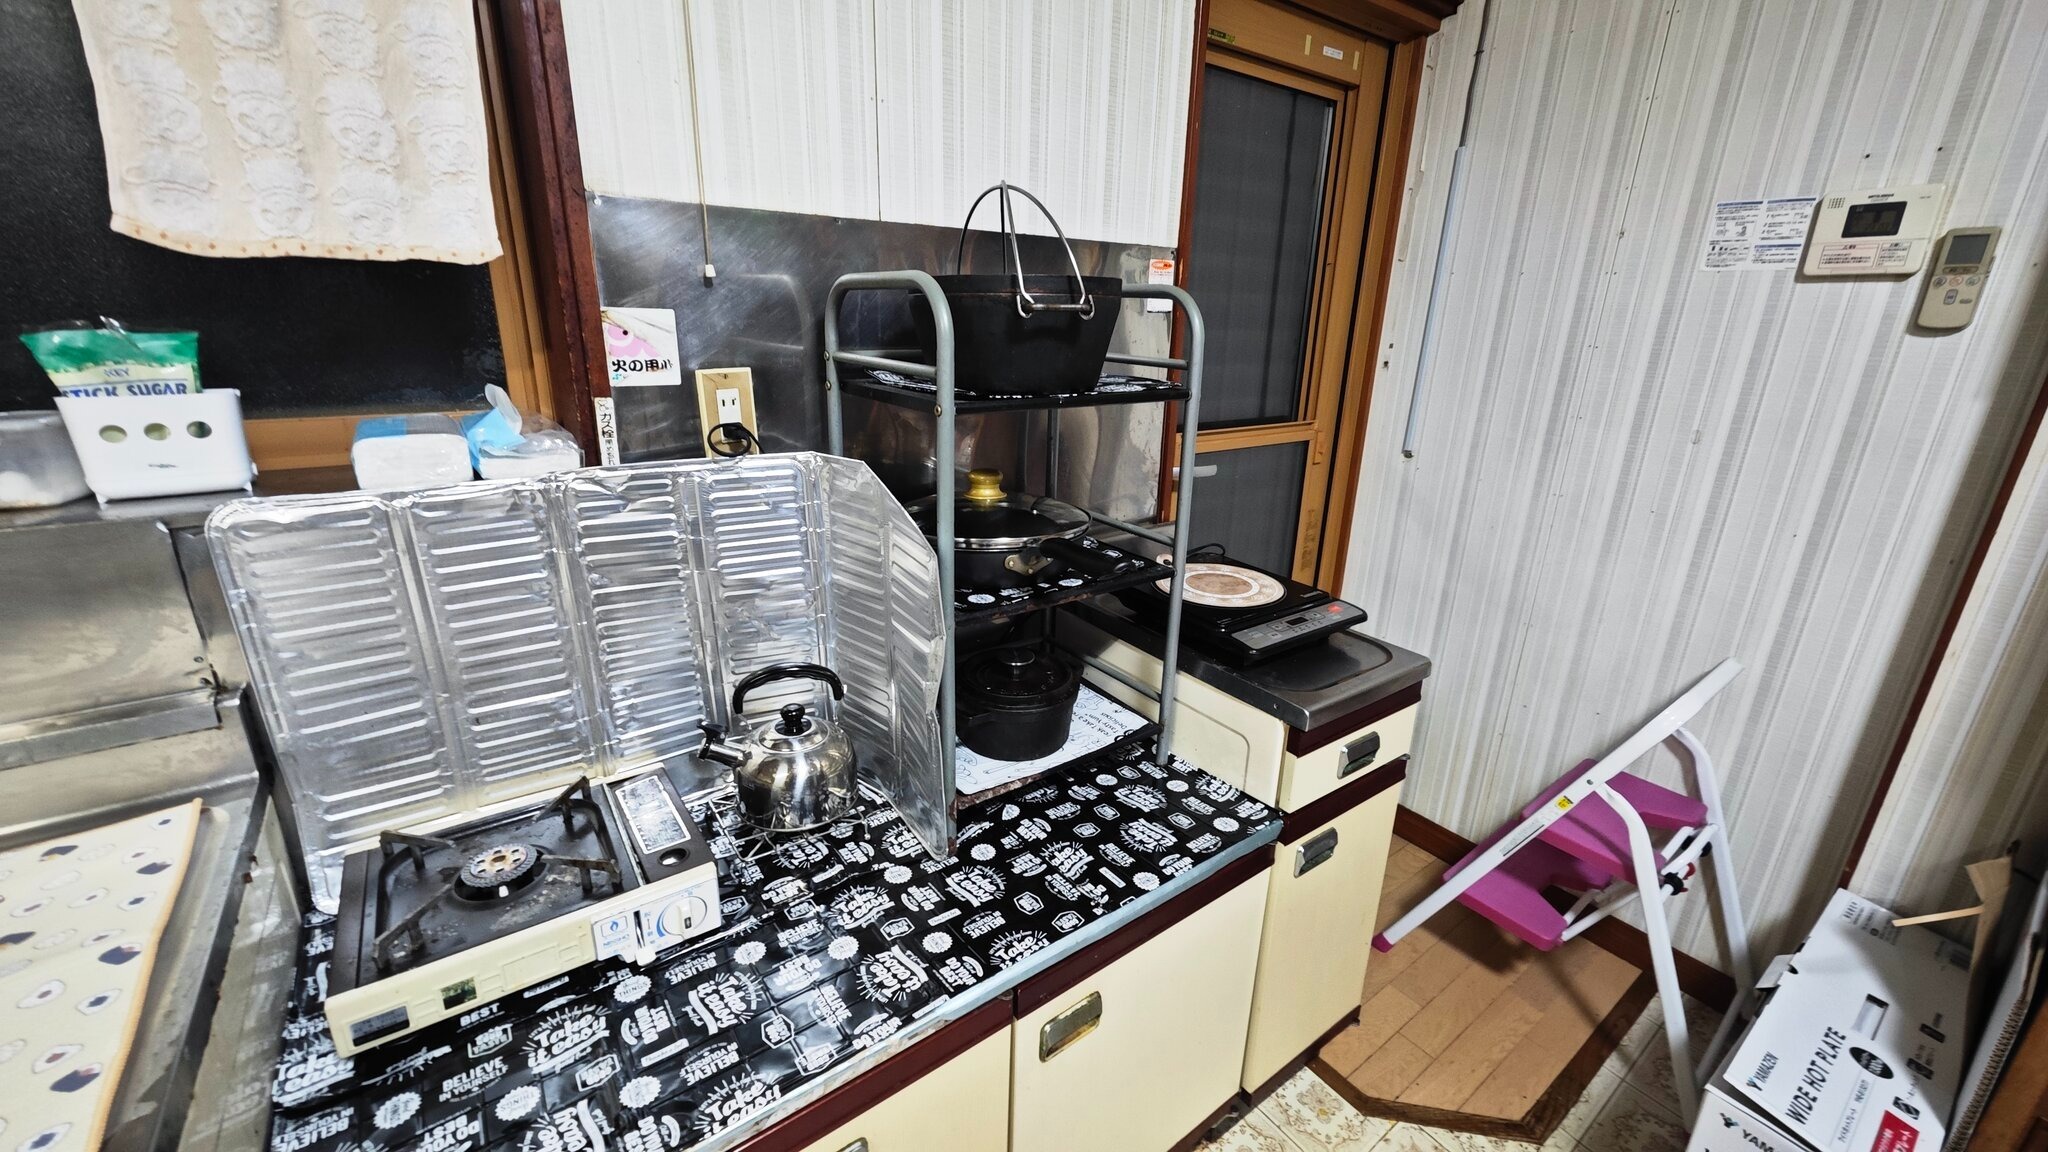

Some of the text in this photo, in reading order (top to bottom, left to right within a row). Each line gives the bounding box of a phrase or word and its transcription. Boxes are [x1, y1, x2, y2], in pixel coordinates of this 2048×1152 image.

[835, 891, 876, 913] Take
[853, 893, 890, 918] easy
[777, 918, 820, 942] BELIEVE
[995, 936, 1034, 960] Take
[670, 957, 717, 985] BELIEVE
[869, 962, 901, 998] Take
[875, 952, 911, 981] easy
[704, 994, 739, 1028] easy
[717, 975, 748, 1015] Take
[460, 1003, 500, 1027] BEST
[534, 1013, 598, 1048] Take
[527, 1047, 552, 1068] it
[552, 1016, 607, 1055] easy
[442, 1056, 504, 1091] BELIEVE
[679, 1049, 729, 1078] YOURSELF
[685, 1051, 740, 1086] BELIEVE
[1754, 1051, 1779, 1084] YAMAZEN
[1785, 1026, 1847, 1126] WIDE HOT PLATE
[439, 1065, 509, 1102] IN YOURSELF
[704, 1081, 764, 1121] Take
[420, 1114, 468, 1147] BEST
[455, 1120, 480, 1141] DO
